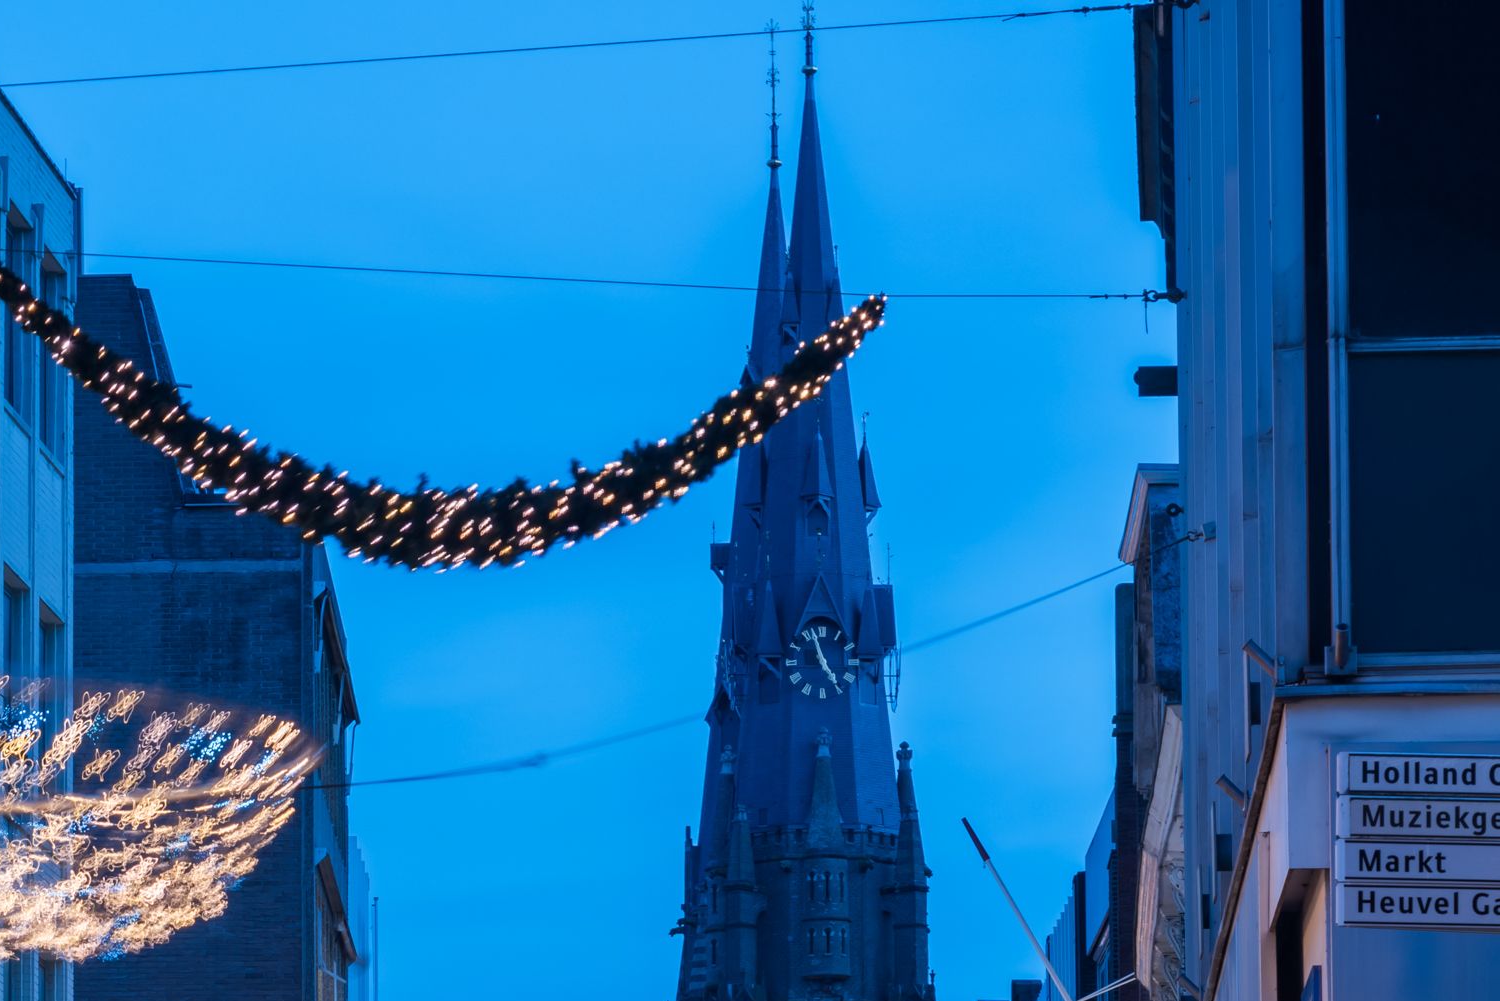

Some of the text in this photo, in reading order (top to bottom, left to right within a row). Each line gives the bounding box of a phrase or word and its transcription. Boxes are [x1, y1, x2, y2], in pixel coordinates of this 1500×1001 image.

[1361, 760, 1477, 785] Holland
[1362, 804, 1500, 836] Muziekge
[1358, 849, 1446, 873] Markt
[1357, 890, 1459, 914] Heuvel
